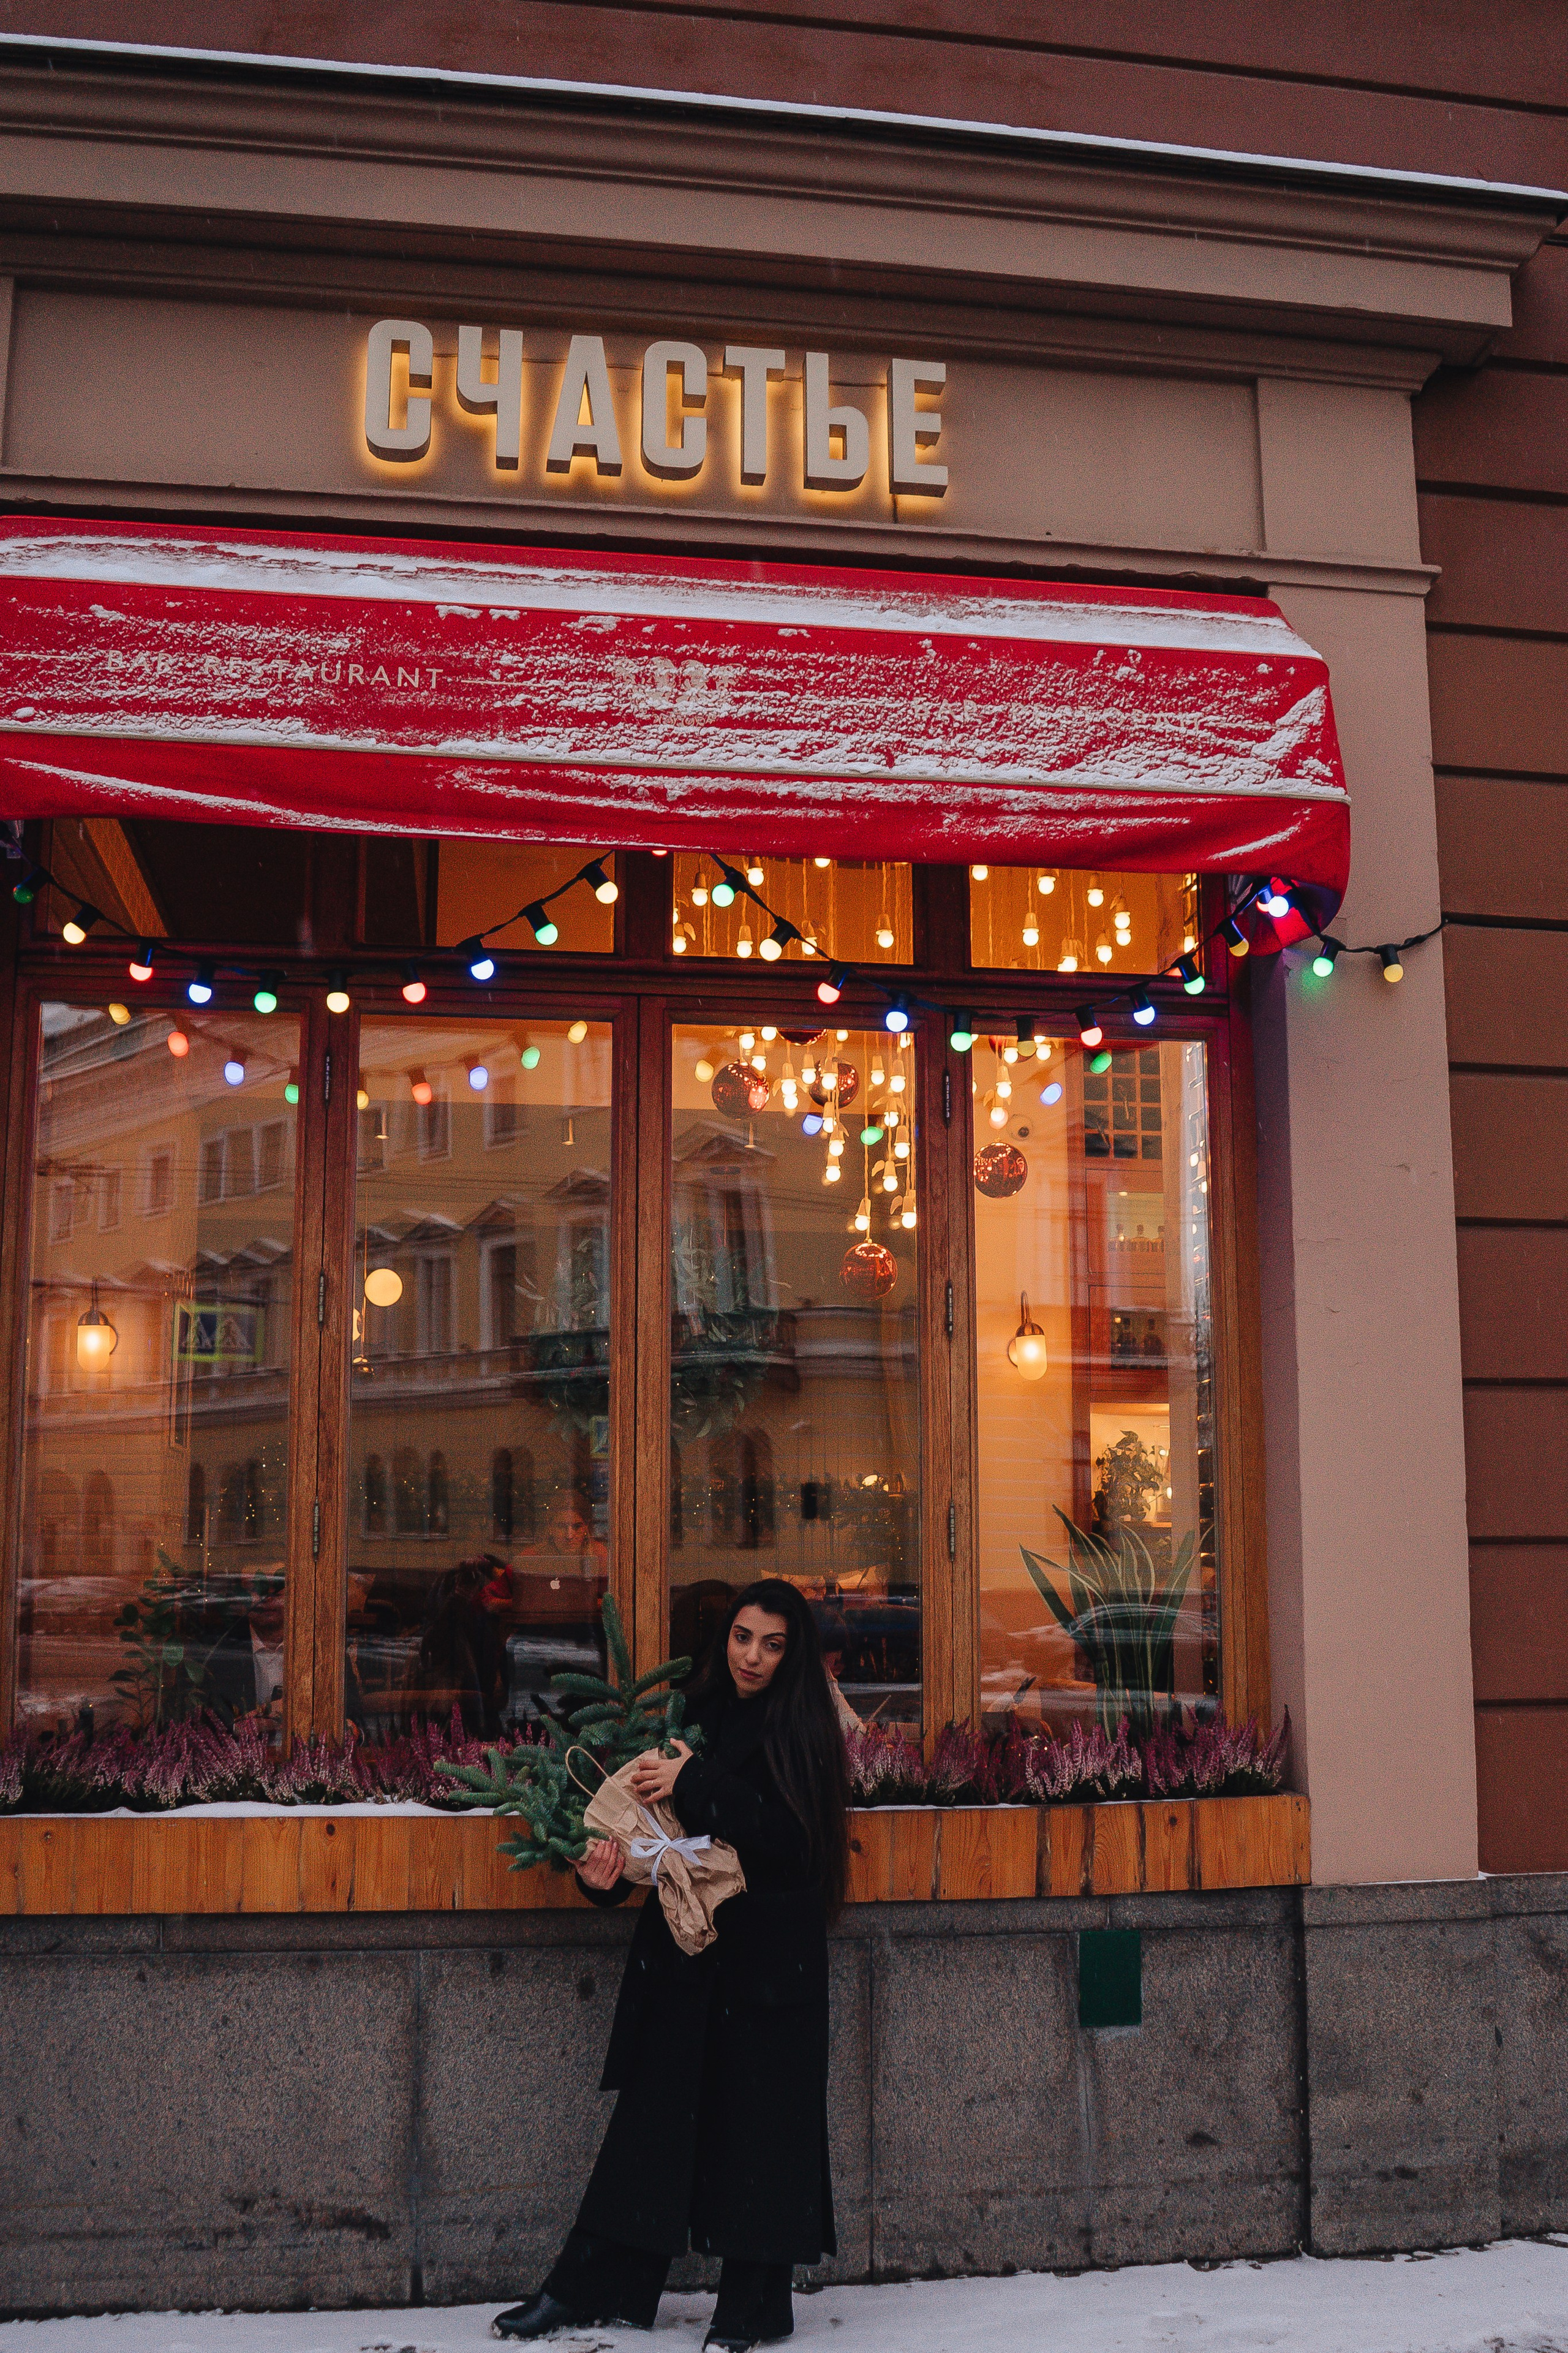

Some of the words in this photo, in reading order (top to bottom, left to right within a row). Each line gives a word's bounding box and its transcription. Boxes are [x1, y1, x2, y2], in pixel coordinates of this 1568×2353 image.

[366, 319, 948, 497] СЧАСТЬЕ
[107, 649, 174, 674] BAR
[205, 654, 444, 690] RESTAURANT
